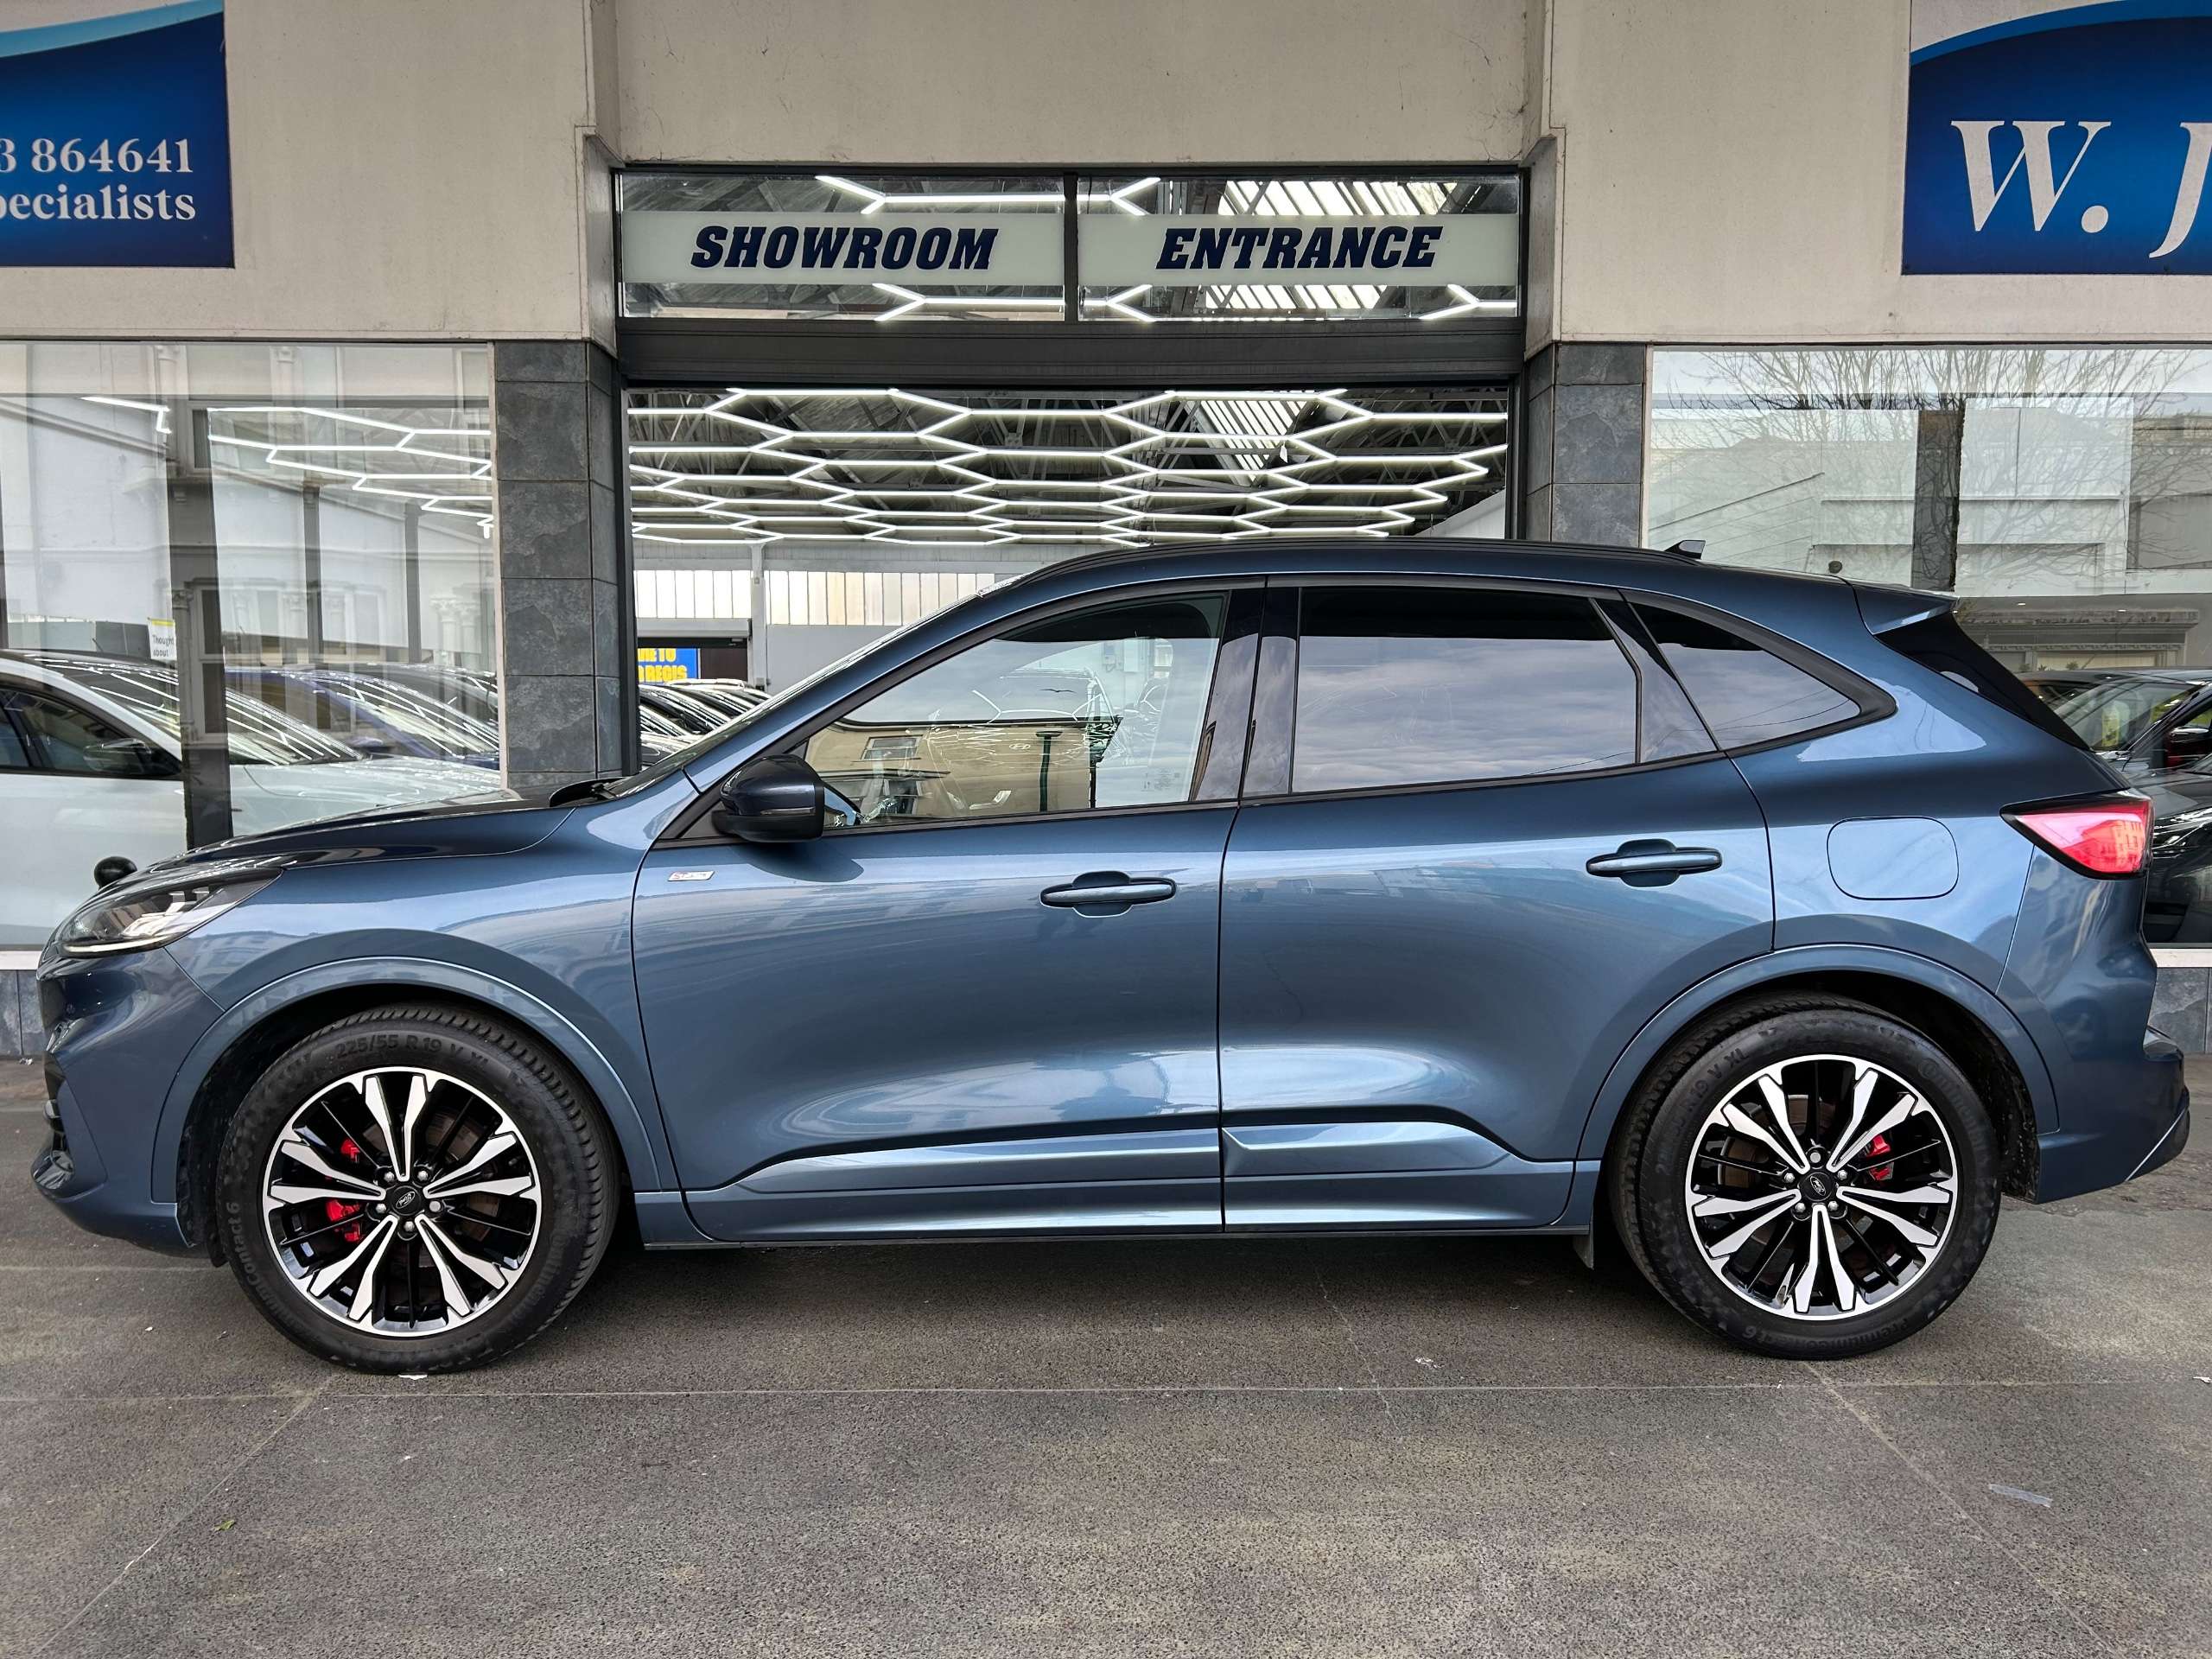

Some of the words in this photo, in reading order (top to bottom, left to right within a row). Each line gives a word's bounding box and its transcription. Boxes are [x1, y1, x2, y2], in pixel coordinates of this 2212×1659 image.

[31, 138, 194, 172] 864641
[1951, 120, 2112, 233] W.
[690, 225, 999, 270] SHOWROOM
[1154, 226, 1444, 270] ENTRANCE
[334, 1033, 399, 1060] 225/55
[421, 1036, 442, 1053] 19
[1723, 1045, 1750, 1069] XL
